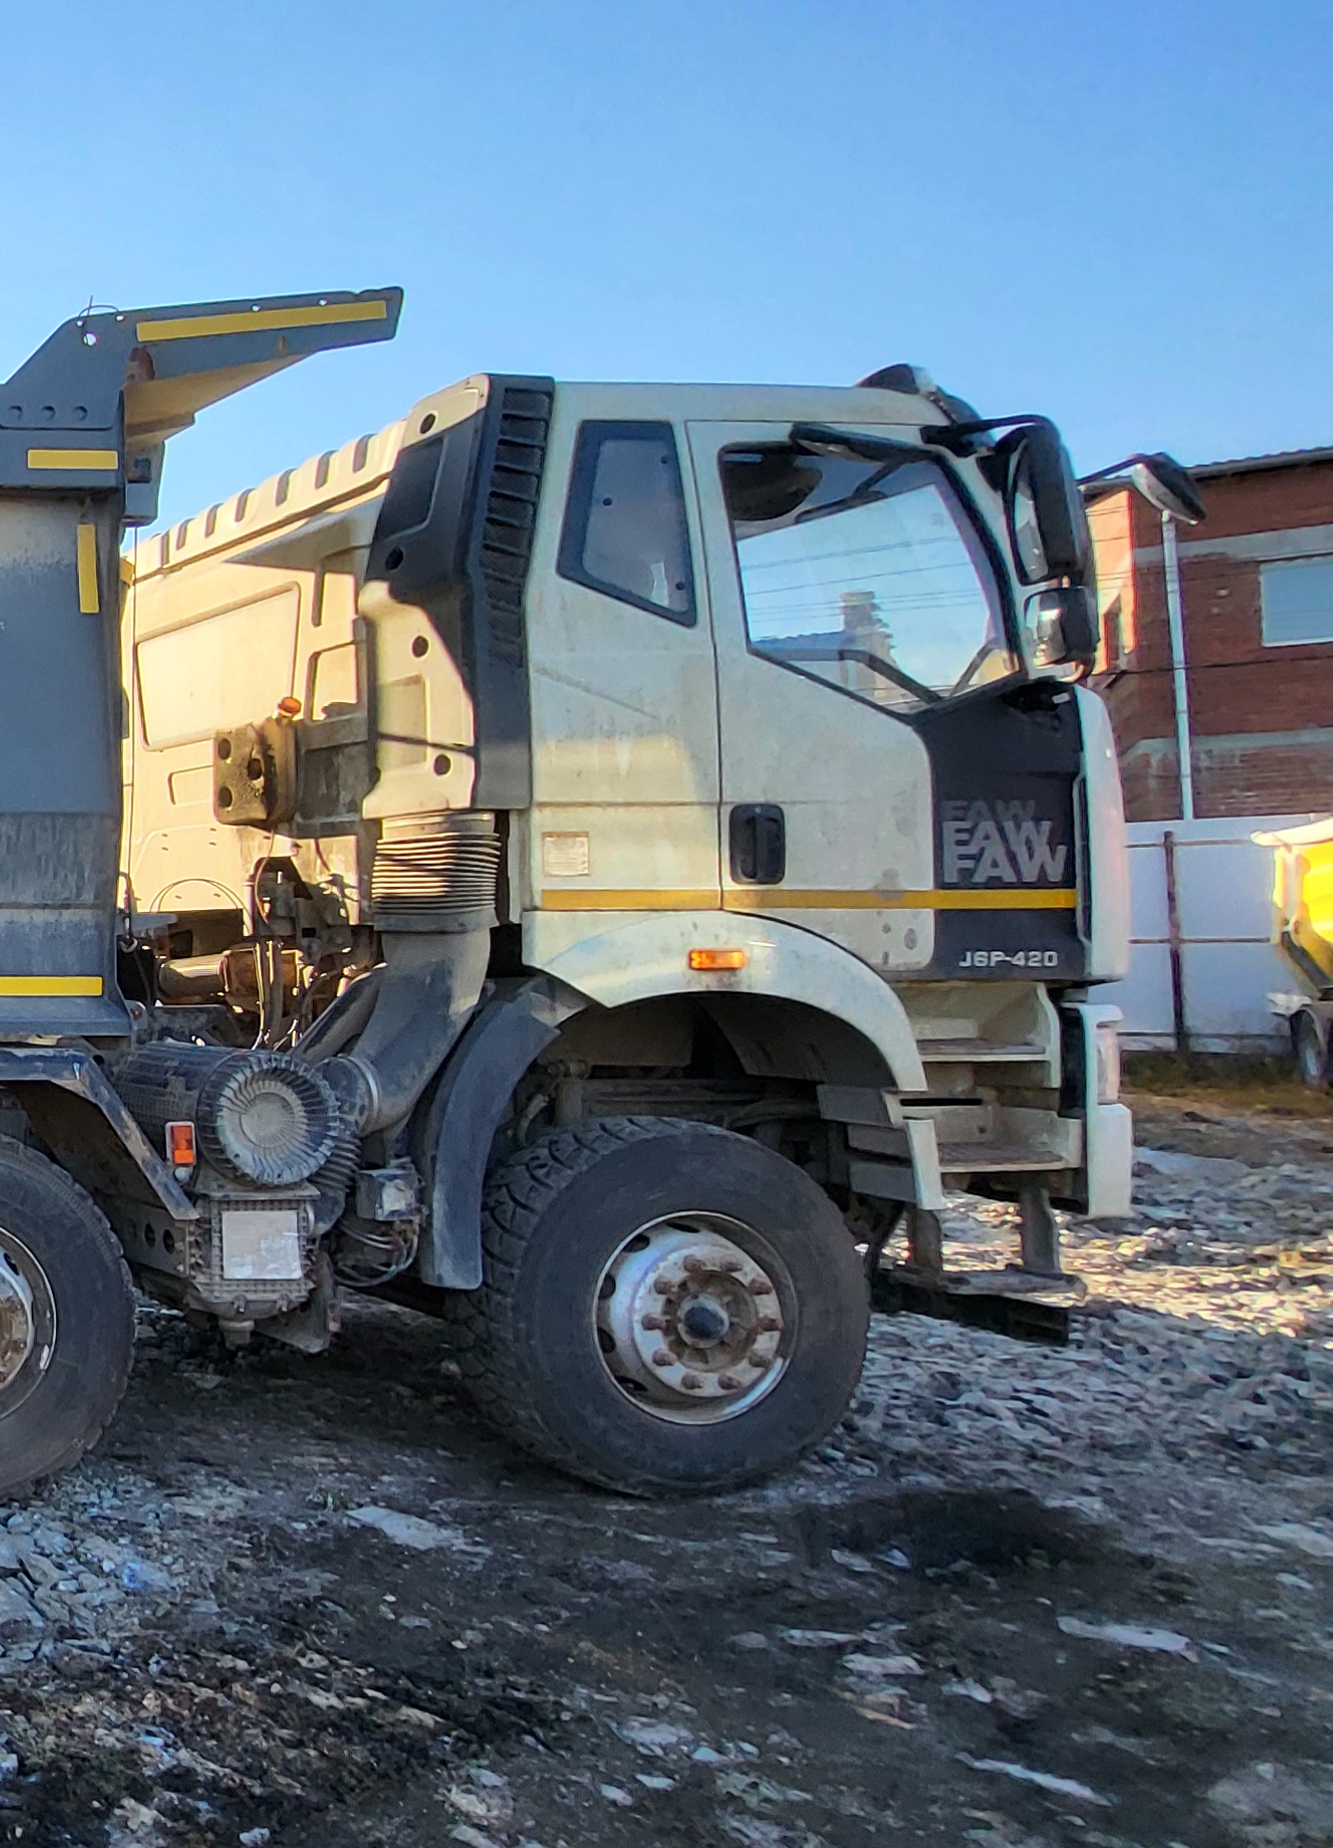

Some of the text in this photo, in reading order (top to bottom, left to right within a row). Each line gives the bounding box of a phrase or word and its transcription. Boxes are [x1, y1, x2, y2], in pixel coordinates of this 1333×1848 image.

[942, 801, 1036, 823] FAW
[942, 821, 1052, 850] FAW
[943, 844, 1068, 883] FAW
[958, 951, 1058, 968] J6P-420
